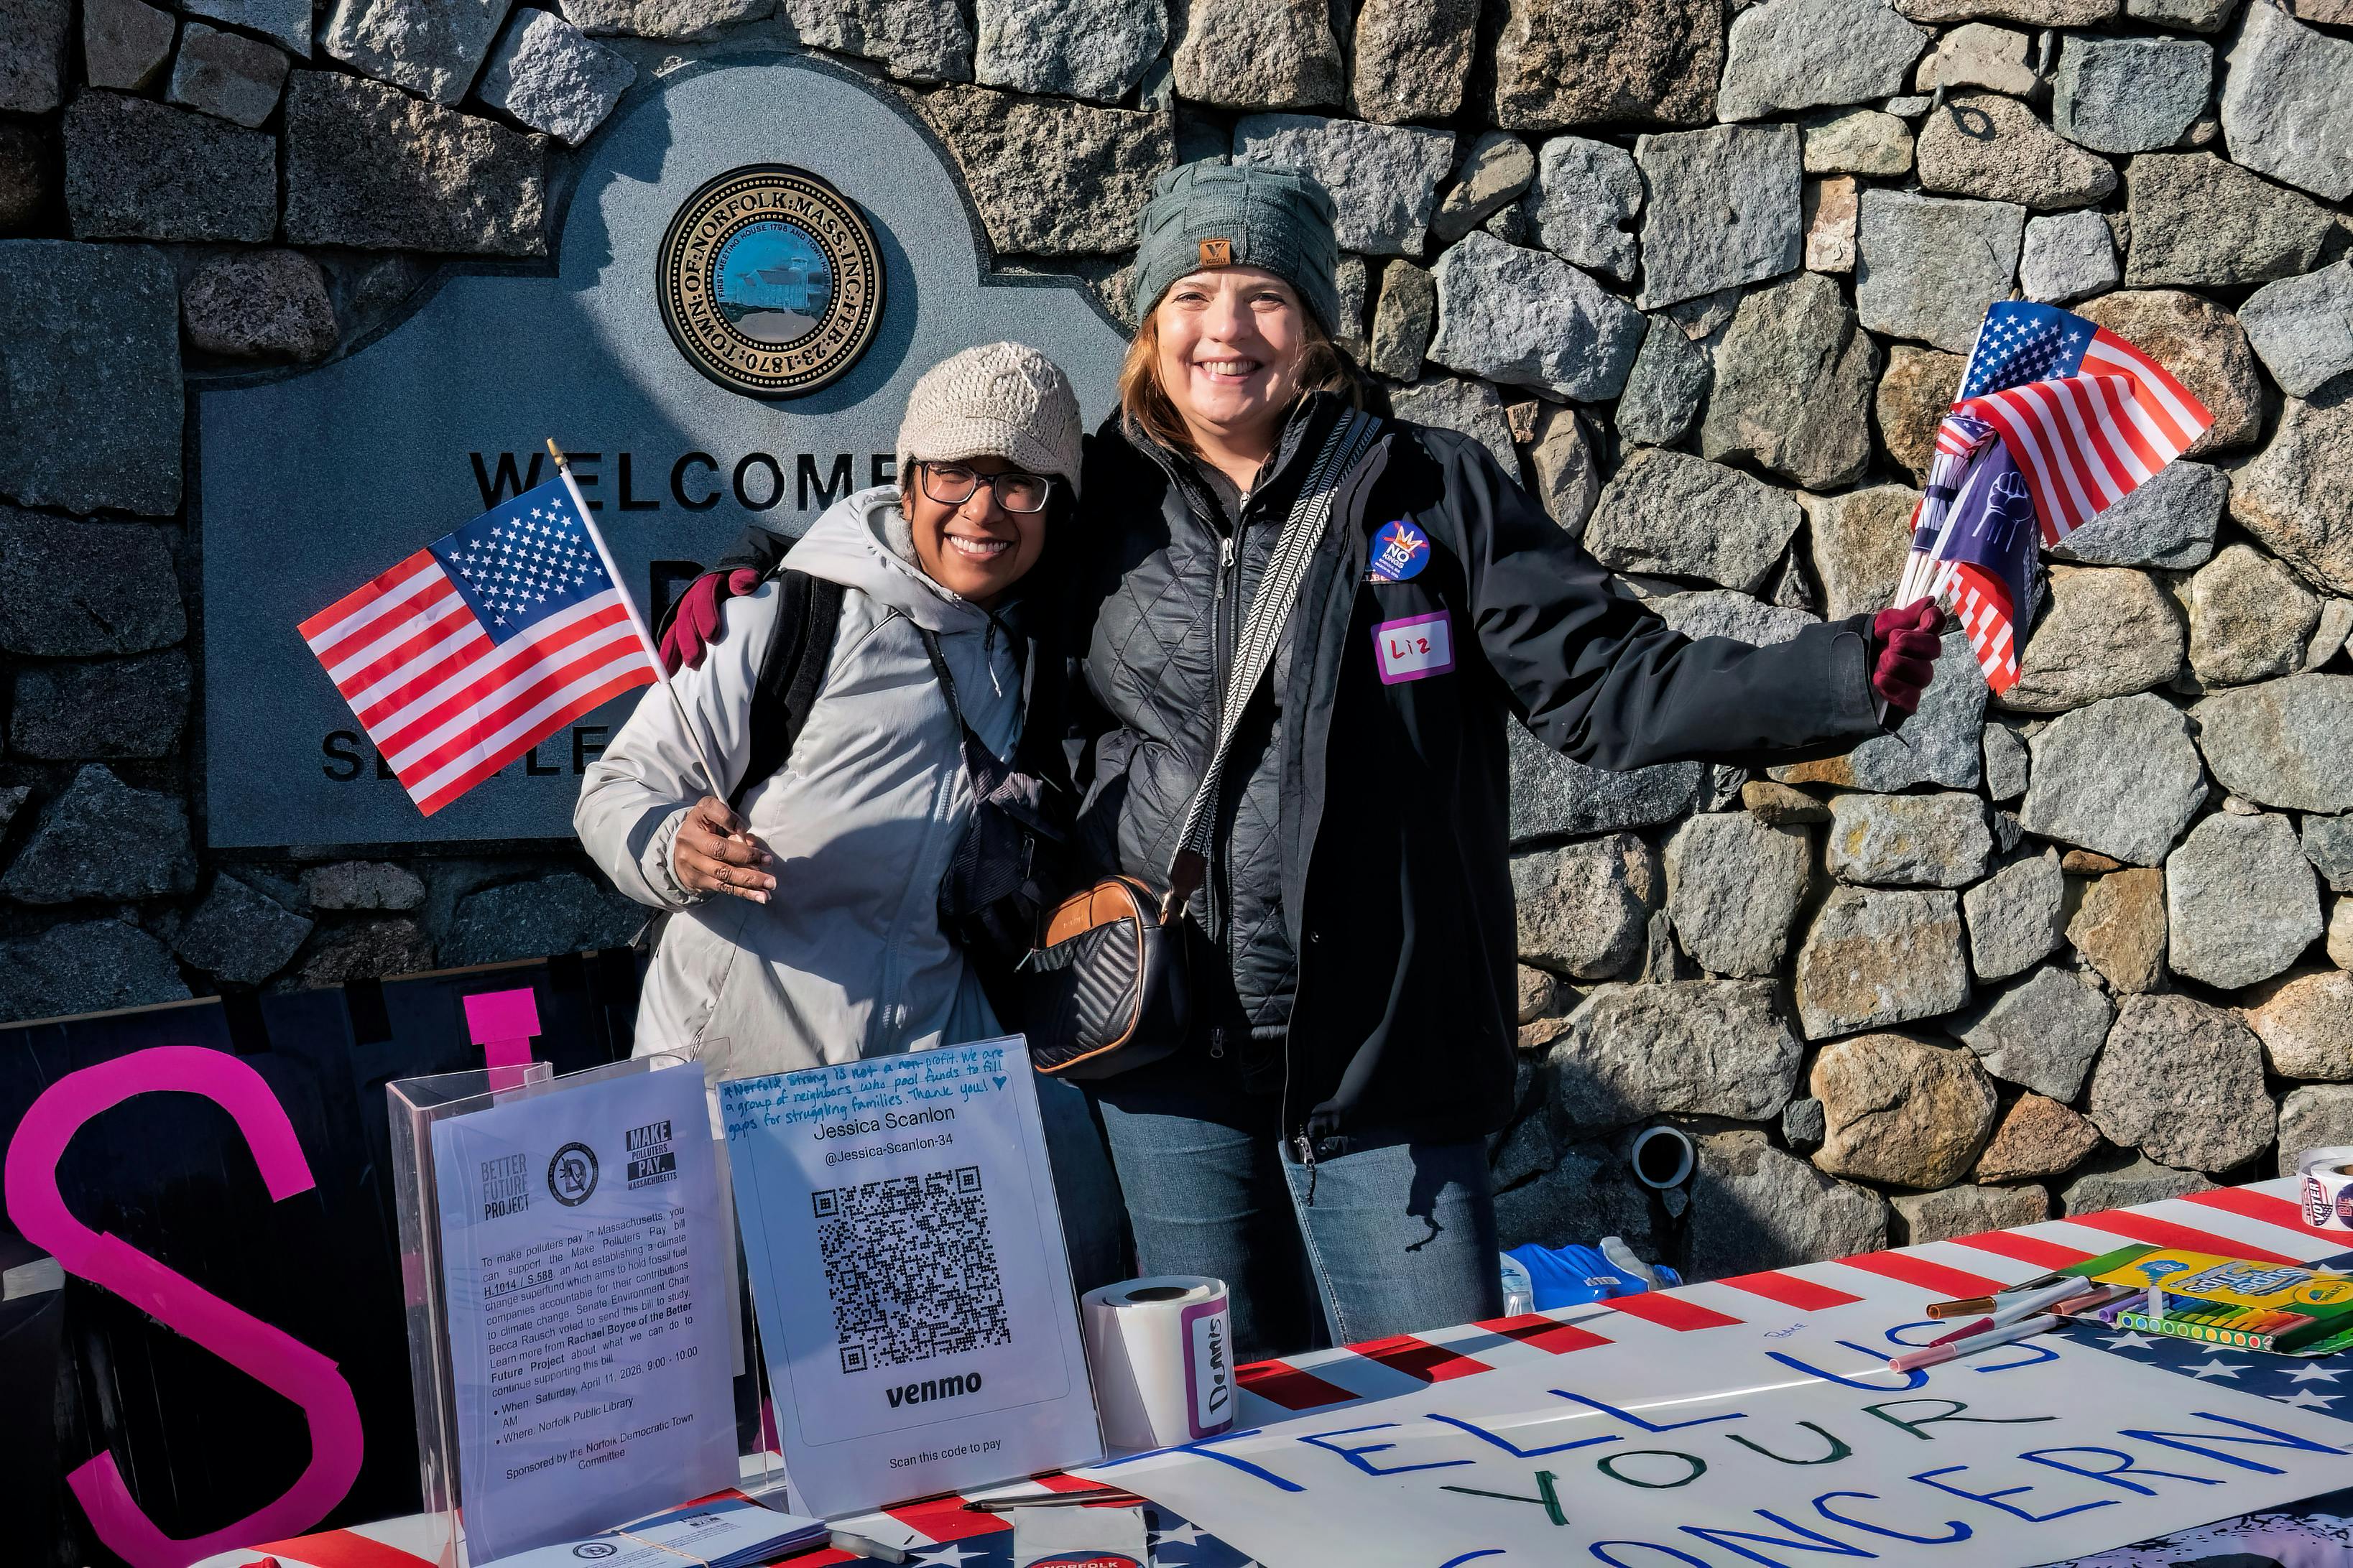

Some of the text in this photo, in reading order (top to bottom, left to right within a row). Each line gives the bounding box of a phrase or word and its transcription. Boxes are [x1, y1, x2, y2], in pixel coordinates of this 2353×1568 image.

[719, 239, 740, 271] MEETING
[741, 224, 767, 240] HOUSE
[790, 229, 805, 240] AND
[1382, 552, 1404, 569] KINGS
[1385, 543, 1410, 562] NO
[1390, 638, 1430, 659] Liz
[726, 1059, 1002, 1118] a group of neighbors who pool funds to fill
[729, 1121, 758, 1141] gaps
[764, 1113, 781, 1127] for
[786, 1103, 848, 1124] struggling
[908, 1086, 953, 1100] Thank
[961, 1079, 989, 1103] you!
[813, 1106, 955, 1141] Jessica Scanlon
[630, 1122, 668, 1149] MAKE
[632, 1143, 667, 1161] POLLUTERS
[825, 1133, 954, 1166] @Jessica-Scanlon-34
[481, 1153, 527, 1182] BETTER
[628, 1172, 677, 1191] MASSACHUSETTS
[638, 1156, 665, 1177] PAY.
[483, 1173, 528, 1203] FUTURE
[485, 1193, 530, 1220] PROJECT
[2308, 1182, 2325, 1221] VOTER
[482, 1258, 493, 1268] To
[497, 1251, 522, 1265] make
[526, 1239, 563, 1256] polluters
[568, 1234, 583, 1247] pay
[587, 1229, 594, 1240] in
[670, 1207, 685, 1220] you
[483, 1219, 685, 1282] can support the Make Polluters Pay bill
[484, 1279, 517, 1297] H.1014
[560, 1266, 570, 1276] an
[574, 1260, 588, 1271] Act
[592, 1245, 644, 1266] establishing
[648, 1243, 653, 1252] a
[657, 1234, 686, 1249] climate
[485, 1246, 688, 1312] change superfund which aims to hold fossil fuel
[2183, 1274, 2239, 1293] Tips
[2234, 1268, 2305, 1294] Super
[486, 1261, 689, 1327] companies accountable for their contributions
[487, 1330, 496, 1340] to
[501, 1320, 532, 1337] climate
[576, 1301, 607, 1314] Senate
[611, 1284, 665, 1305] Environment
[668, 1276, 690, 1288] Chair
[489, 1288, 691, 1355] Becca Rausch voted to send this bill to study.
[490, 1302, 693, 1369] Learn more from Rachael Boyce of the Better
[491, 1315, 693, 1383] Future Project about what we can do to
[492, 1380, 532, 1398] continue
[534, 1365, 581, 1387] supporting
[583, 1358, 598, 1370] this
[535, 1386, 578, 1404] Saturday,
[581, 1377, 601, 1392] April
[647, 1356, 666, 1371] 9:00
[675, 1346, 698, 1362] 10:00
[885, 1371, 982, 1409] venmo
[503, 1416, 518, 1429] AM
[539, 1415, 570, 1433] Norfolk
[574, 1407, 601, 1422] Public
[604, 1397, 634, 1414] Library
[1088, 1320, 2061, 1492] TELL US
[507, 1413, 694, 1480] Sponsored by the Norfolk Democratic Town
[578, 1449, 626, 1470] Committee
[889, 1439, 1002, 1470] Scan this code to pay
[1440, 1398, 2061, 1526] YOUR
[1439, 1412, 2352, 1568] ONCERN
